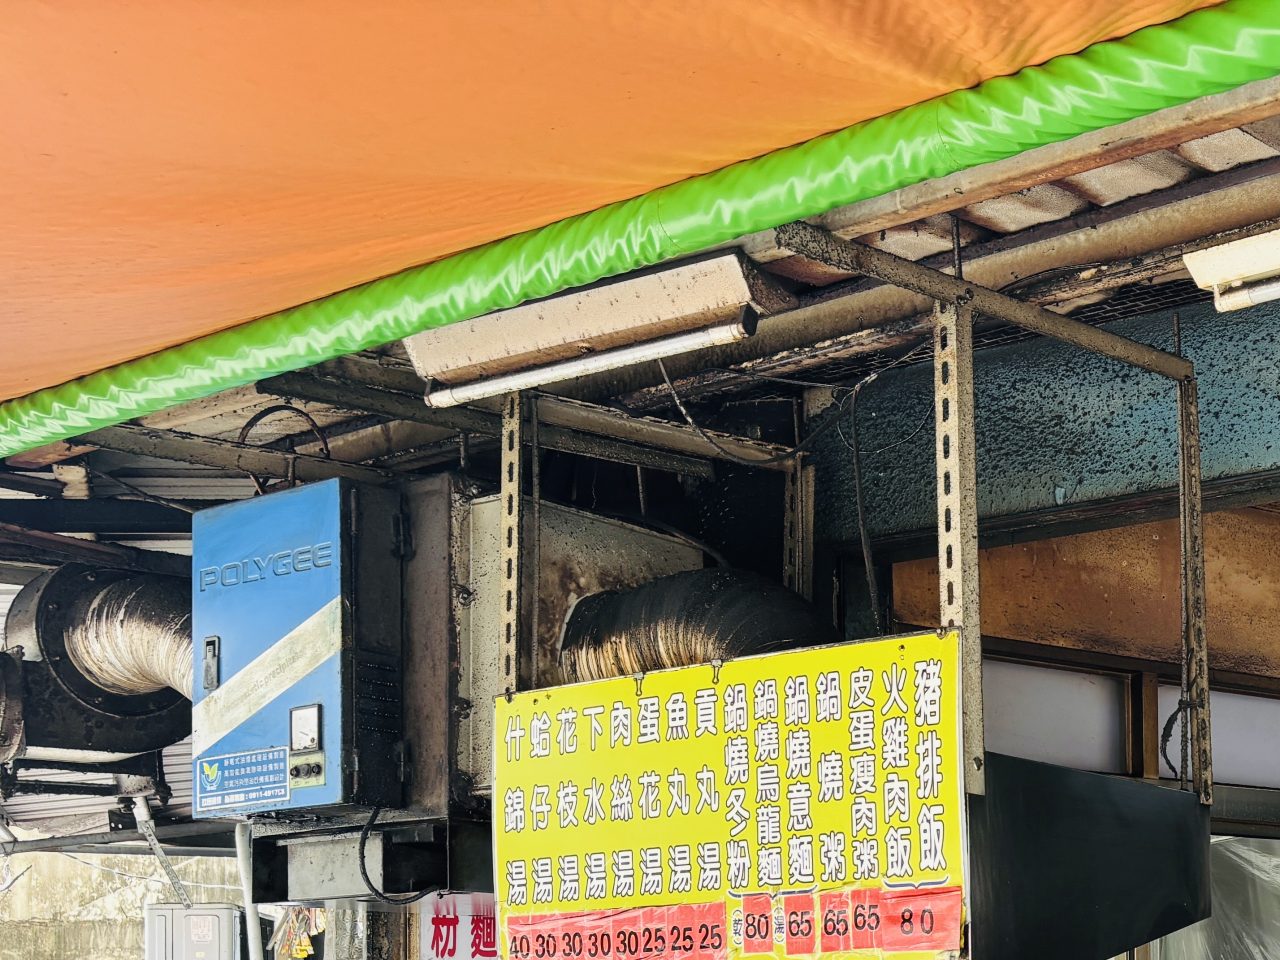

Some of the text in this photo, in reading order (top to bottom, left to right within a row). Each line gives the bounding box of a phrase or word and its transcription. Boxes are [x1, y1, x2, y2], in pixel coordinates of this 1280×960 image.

[200, 541, 332, 592] POLYGEE
[504, 714, 527, 906] 什錦湯
[530, 711, 553, 904] 蛤仔湯
[556, 706, 580, 903] 花枝湯
[583, 704, 607, 900] 下水湯
[610, 700, 634, 898] 肉絲湯
[637, 695, 663, 896] 蛋花湯
[665, 691, 692, 894] 魚丸湯
[694, 687, 721, 892] 貢丸湯
[723, 683, 751, 889] 鍋燒冬粉
[753, 678, 783, 887] 鍋燒烏龍麵
[784, 674, 815, 885] 鍋燒意麵
[816, 670, 846, 882] 鍋燒粥
[848, 666, 880, 881] 皮蛋瘦肉粥
[881, 662, 913, 878] 火雞肉飯
[913, 658, 947, 873] 豬排飯
[510, 934, 530, 959] 40
[535, 933, 557, 958] 30
[562, 932, 583, 957] 30
[588, 932, 611, 957] 30
[616, 930, 638, 956] 30
[642, 927, 666, 953] 25
[670, 925, 694, 952] 25
[698, 923, 722, 950] 25
[745, 912, 769, 939] 80
[788, 910, 812, 937] 65
[823, 909, 848, 936] 65
[853, 903, 880, 931] 65
